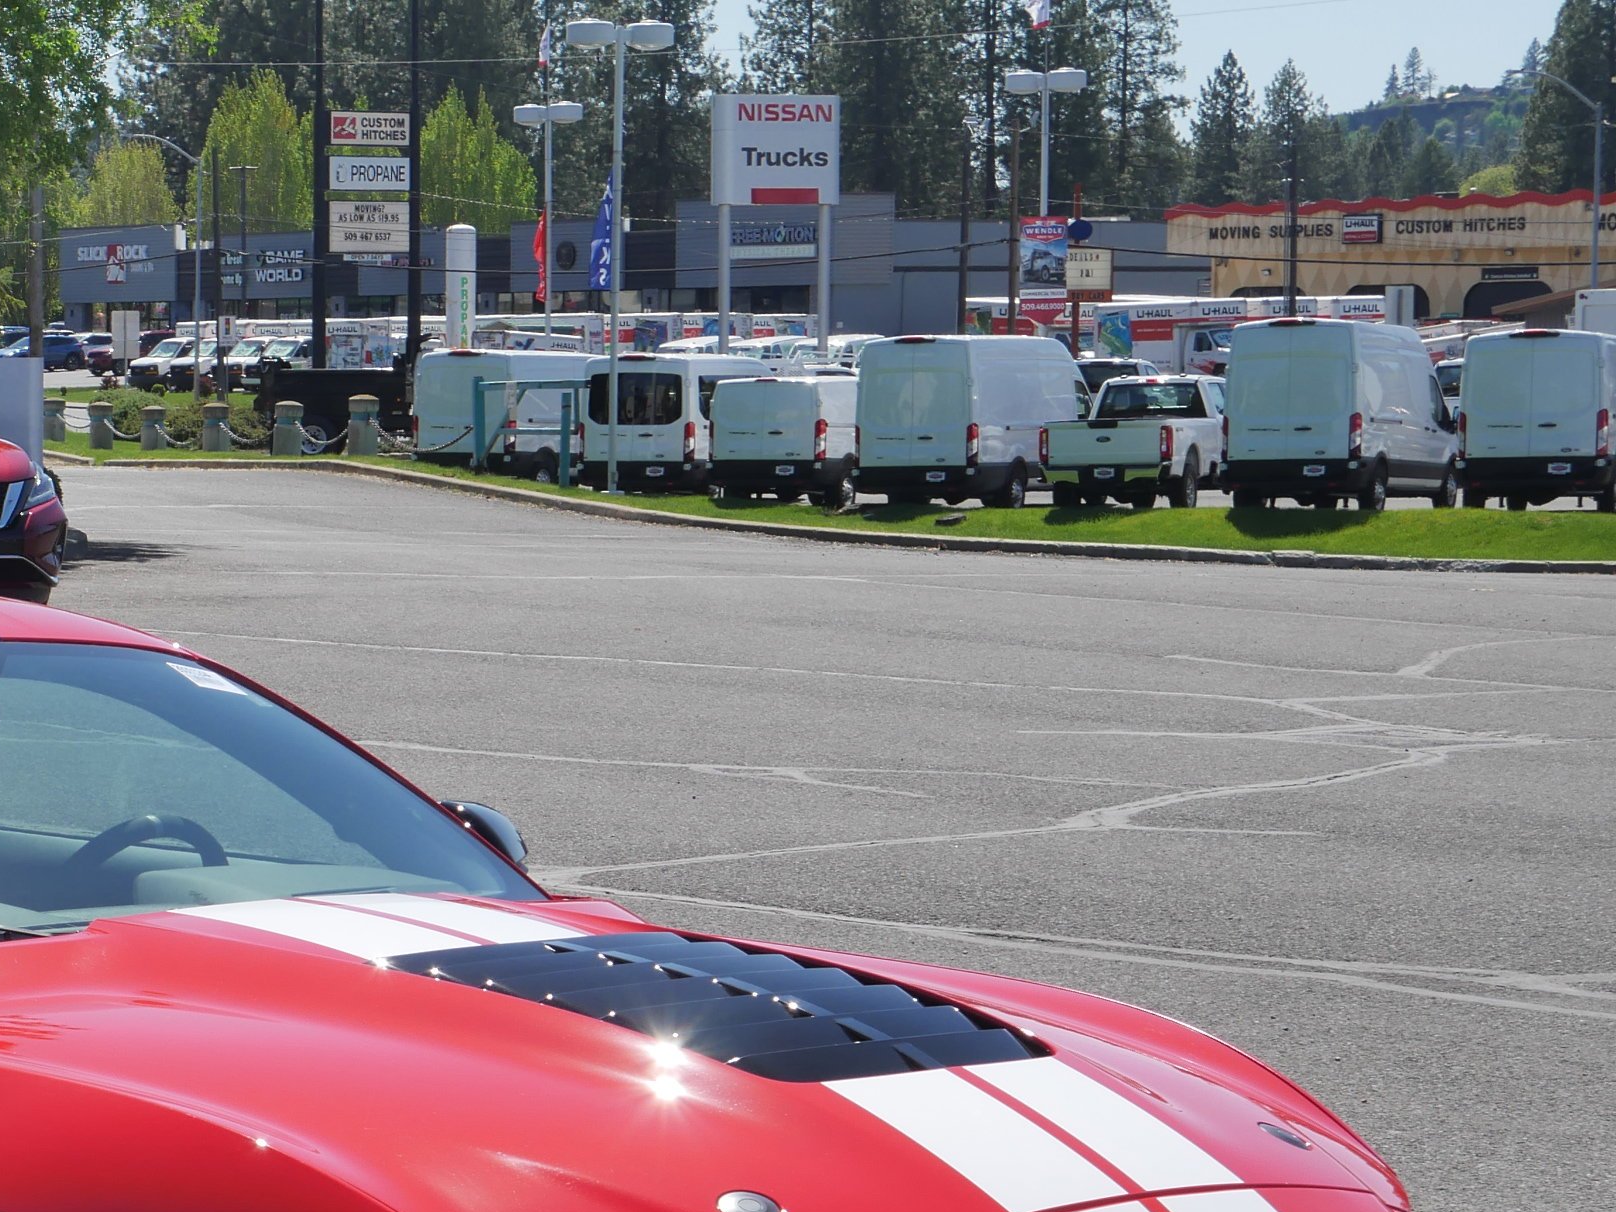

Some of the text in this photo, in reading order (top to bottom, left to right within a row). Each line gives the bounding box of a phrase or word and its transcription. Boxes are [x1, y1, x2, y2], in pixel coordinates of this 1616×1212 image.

[738, 103, 833, 122] NISSAN
[360, 117, 405, 128] CUSTOM
[361, 130, 407, 140] HITCHES
[741, 147, 829, 167] Trucks
[350, 165, 406, 182] PROPANE
[354, 204, 386, 213] MOVING?
[338, 214, 400, 222] AS LOW AS $19.95
[1209, 226, 1261, 240] MOVING
[1269, 224, 1333, 239] SUPLIES
[1395, 217, 1526, 234] CUSTOM HITCHES
[344, 232, 358, 240] 509
[359, 232, 373, 240] 467
[77, 246, 108, 261] SLICK
[265, 249, 304, 264] GAME
[255, 269, 303, 282] WORLD
[460, 276, 468, 348] PROPAN
[1136, 309, 1173, 318] U-HAUL
[1202, 306, 1242, 316] U-HAUL
[1342, 303, 1381, 313] U-HAUL
